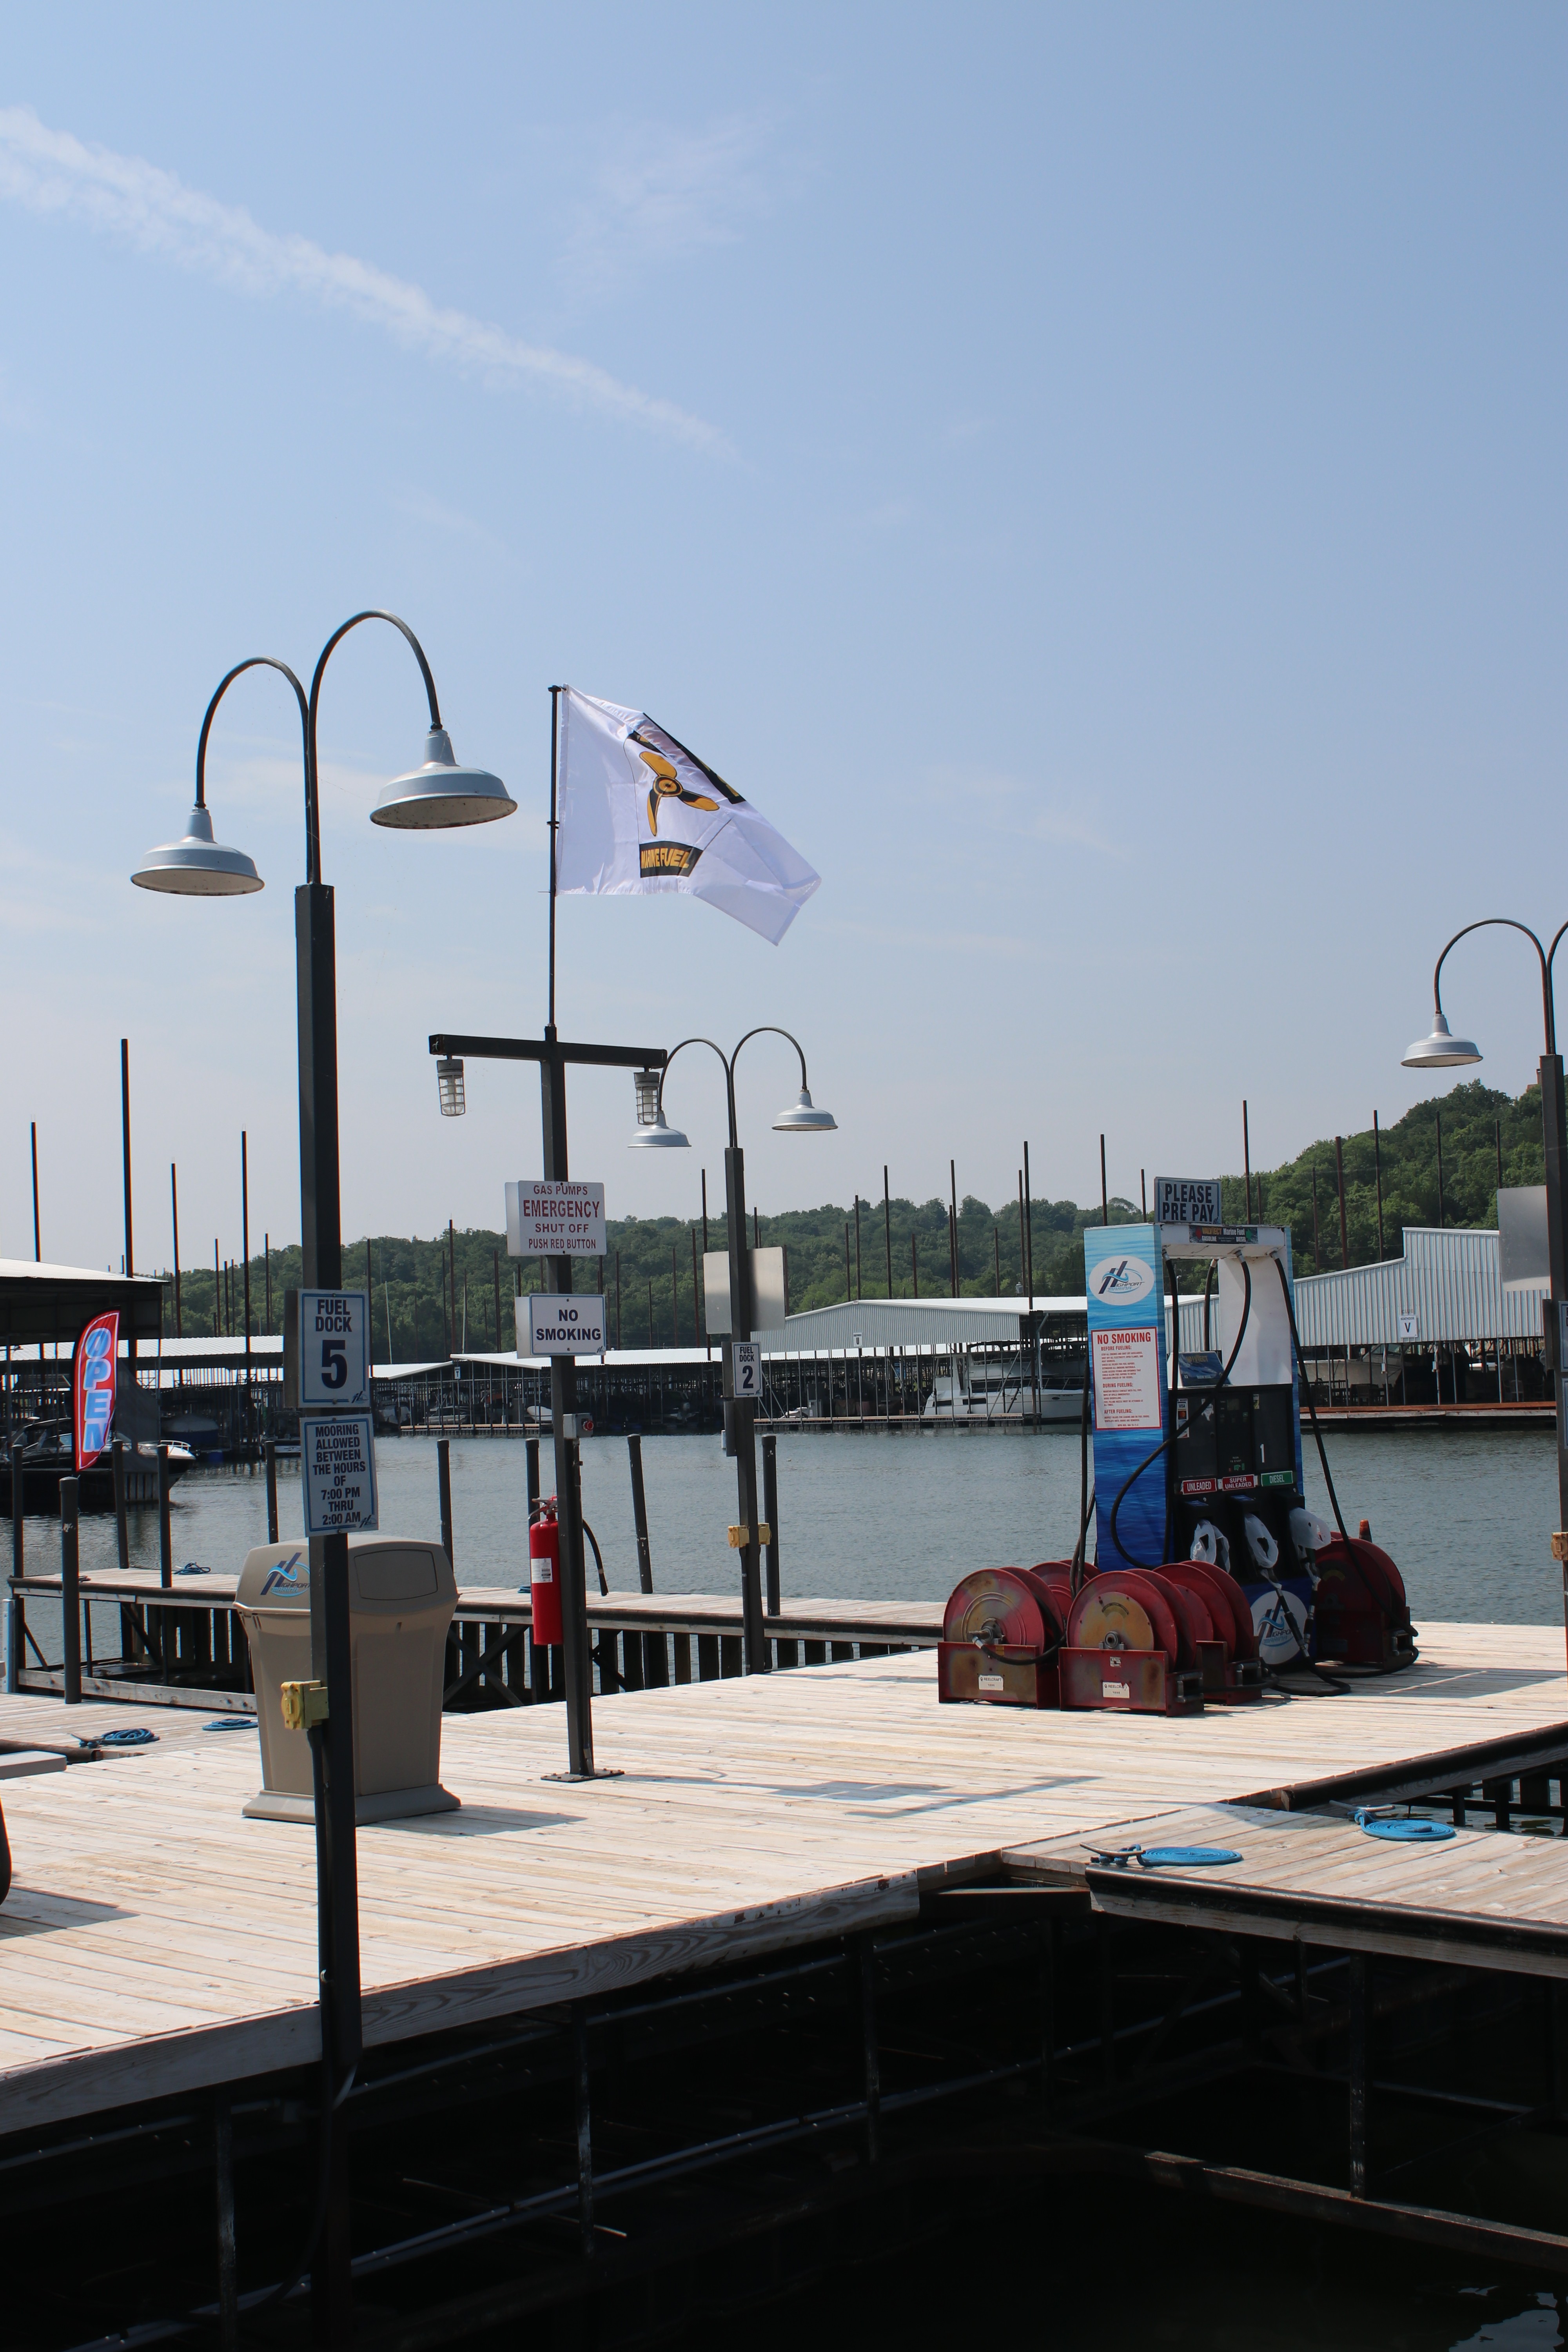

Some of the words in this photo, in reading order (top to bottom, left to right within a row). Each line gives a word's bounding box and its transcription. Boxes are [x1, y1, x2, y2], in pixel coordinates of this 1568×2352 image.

[660, 848, 690, 868] FUEL
[534, 1185, 552, 1194] GAS
[556, 1185, 588, 1195] PUMPS
[1165, 1183, 1212, 1203] PLEASE
[523, 1200, 600, 1218] EMERGENCY
[1163, 1202, 1187, 1221] PRE
[1192, 1203, 1214, 1222] PAY
[535, 1223, 564, 1233] SHUT
[569, 1224, 589, 1233] OFF
[529, 1239, 548, 1249] PUSH
[551, 1239, 564, 1249] RED
[567, 1239, 596, 1249] BUTTON
[318, 1299, 350, 1315] FUEL
[559, 1309, 579, 1321] NO
[316, 1316, 352, 1332] DOCK
[1405, 1322, 1410, 1332] V
[536, 1328, 601, 1340] SMOKING
[1097, 1334, 1109, 1345] NO
[1112, 1332, 1151, 1344] SMOKING
[321, 1340, 347, 1389] 5
[742, 1365, 753, 1388] 2
[83, 1328, 113, 1452] OPEN
[316, 1424, 359, 1437] MOORING
[316, 1437, 360, 1450] ALLOWED
[316, 1449, 361, 1463] BETWEEN
[1260, 1444, 1265, 1463] 1
[313, 1464, 331, 1475] THE
[334, 1461, 366, 1474] HOURS
[334, 1475, 346, 1486] OF
[1269, 1475, 1285, 1484] DIESEL
[1187, 1481, 1211, 1492] UNLEADED
[321, 1489, 342, 1500] 7:00
[345, 1487, 360, 1498] PM
[328, 1500, 353, 1512] THRU
[323, 1513, 343, 1525] 2:00
[345, 1512, 361, 1524] AM
